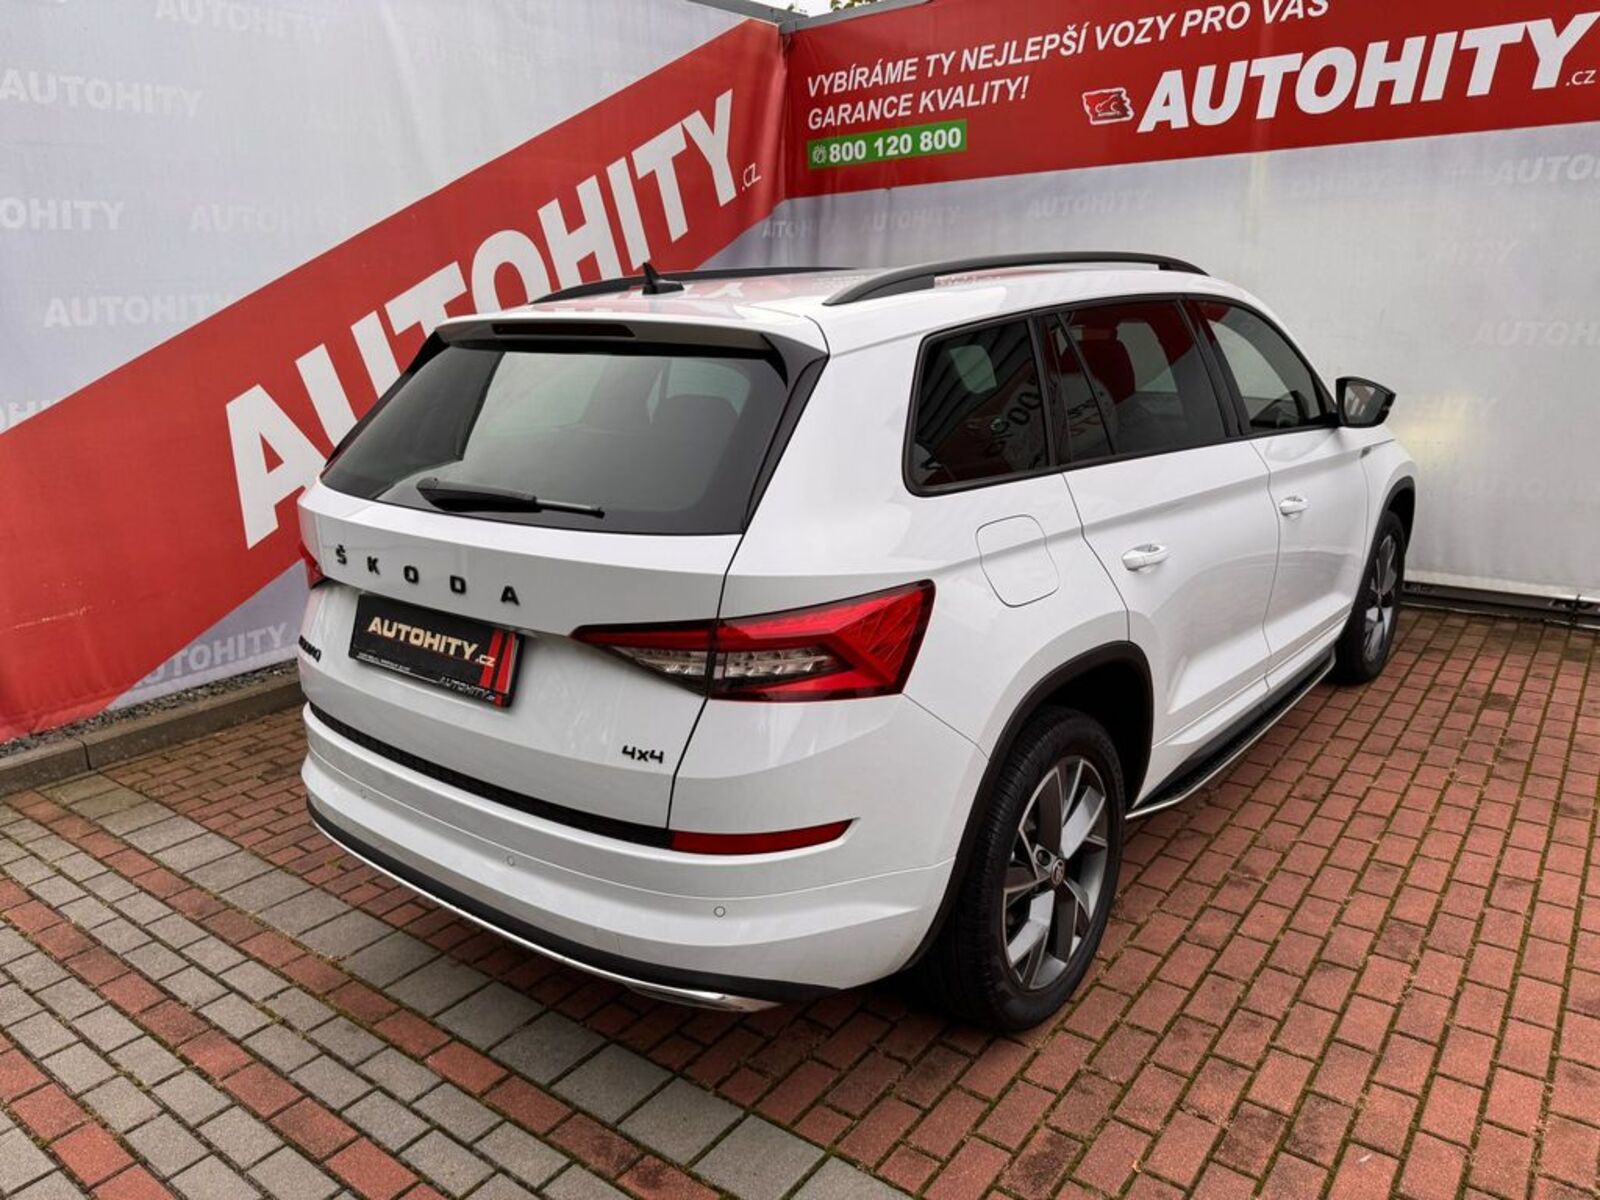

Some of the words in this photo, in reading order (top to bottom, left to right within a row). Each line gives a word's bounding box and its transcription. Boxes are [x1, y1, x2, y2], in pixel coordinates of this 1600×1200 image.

[807, 58, 919, 98] VYBÍRÁME
[925, 51, 957, 79] TY
[960, 21, 1090, 73] NEJLEPŠÍ
[1095, 12, 1176, 51] VOZY
[1181, 2, 1251, 38] PRO
[0, 68, 204, 118] AUTOHITY
[808, 92, 915, 131] GARANCE
[918, 75, 1031, 114] KVALITY!
[829, 140, 867, 164] 800
[874, 133, 913, 158] 120
[919, 126, 962, 152] 800
[334, 543, 520, 606] ŠKODA
[145, 622, 288, 685] TOHITY
[621, 743, 665, 764] 4x4
